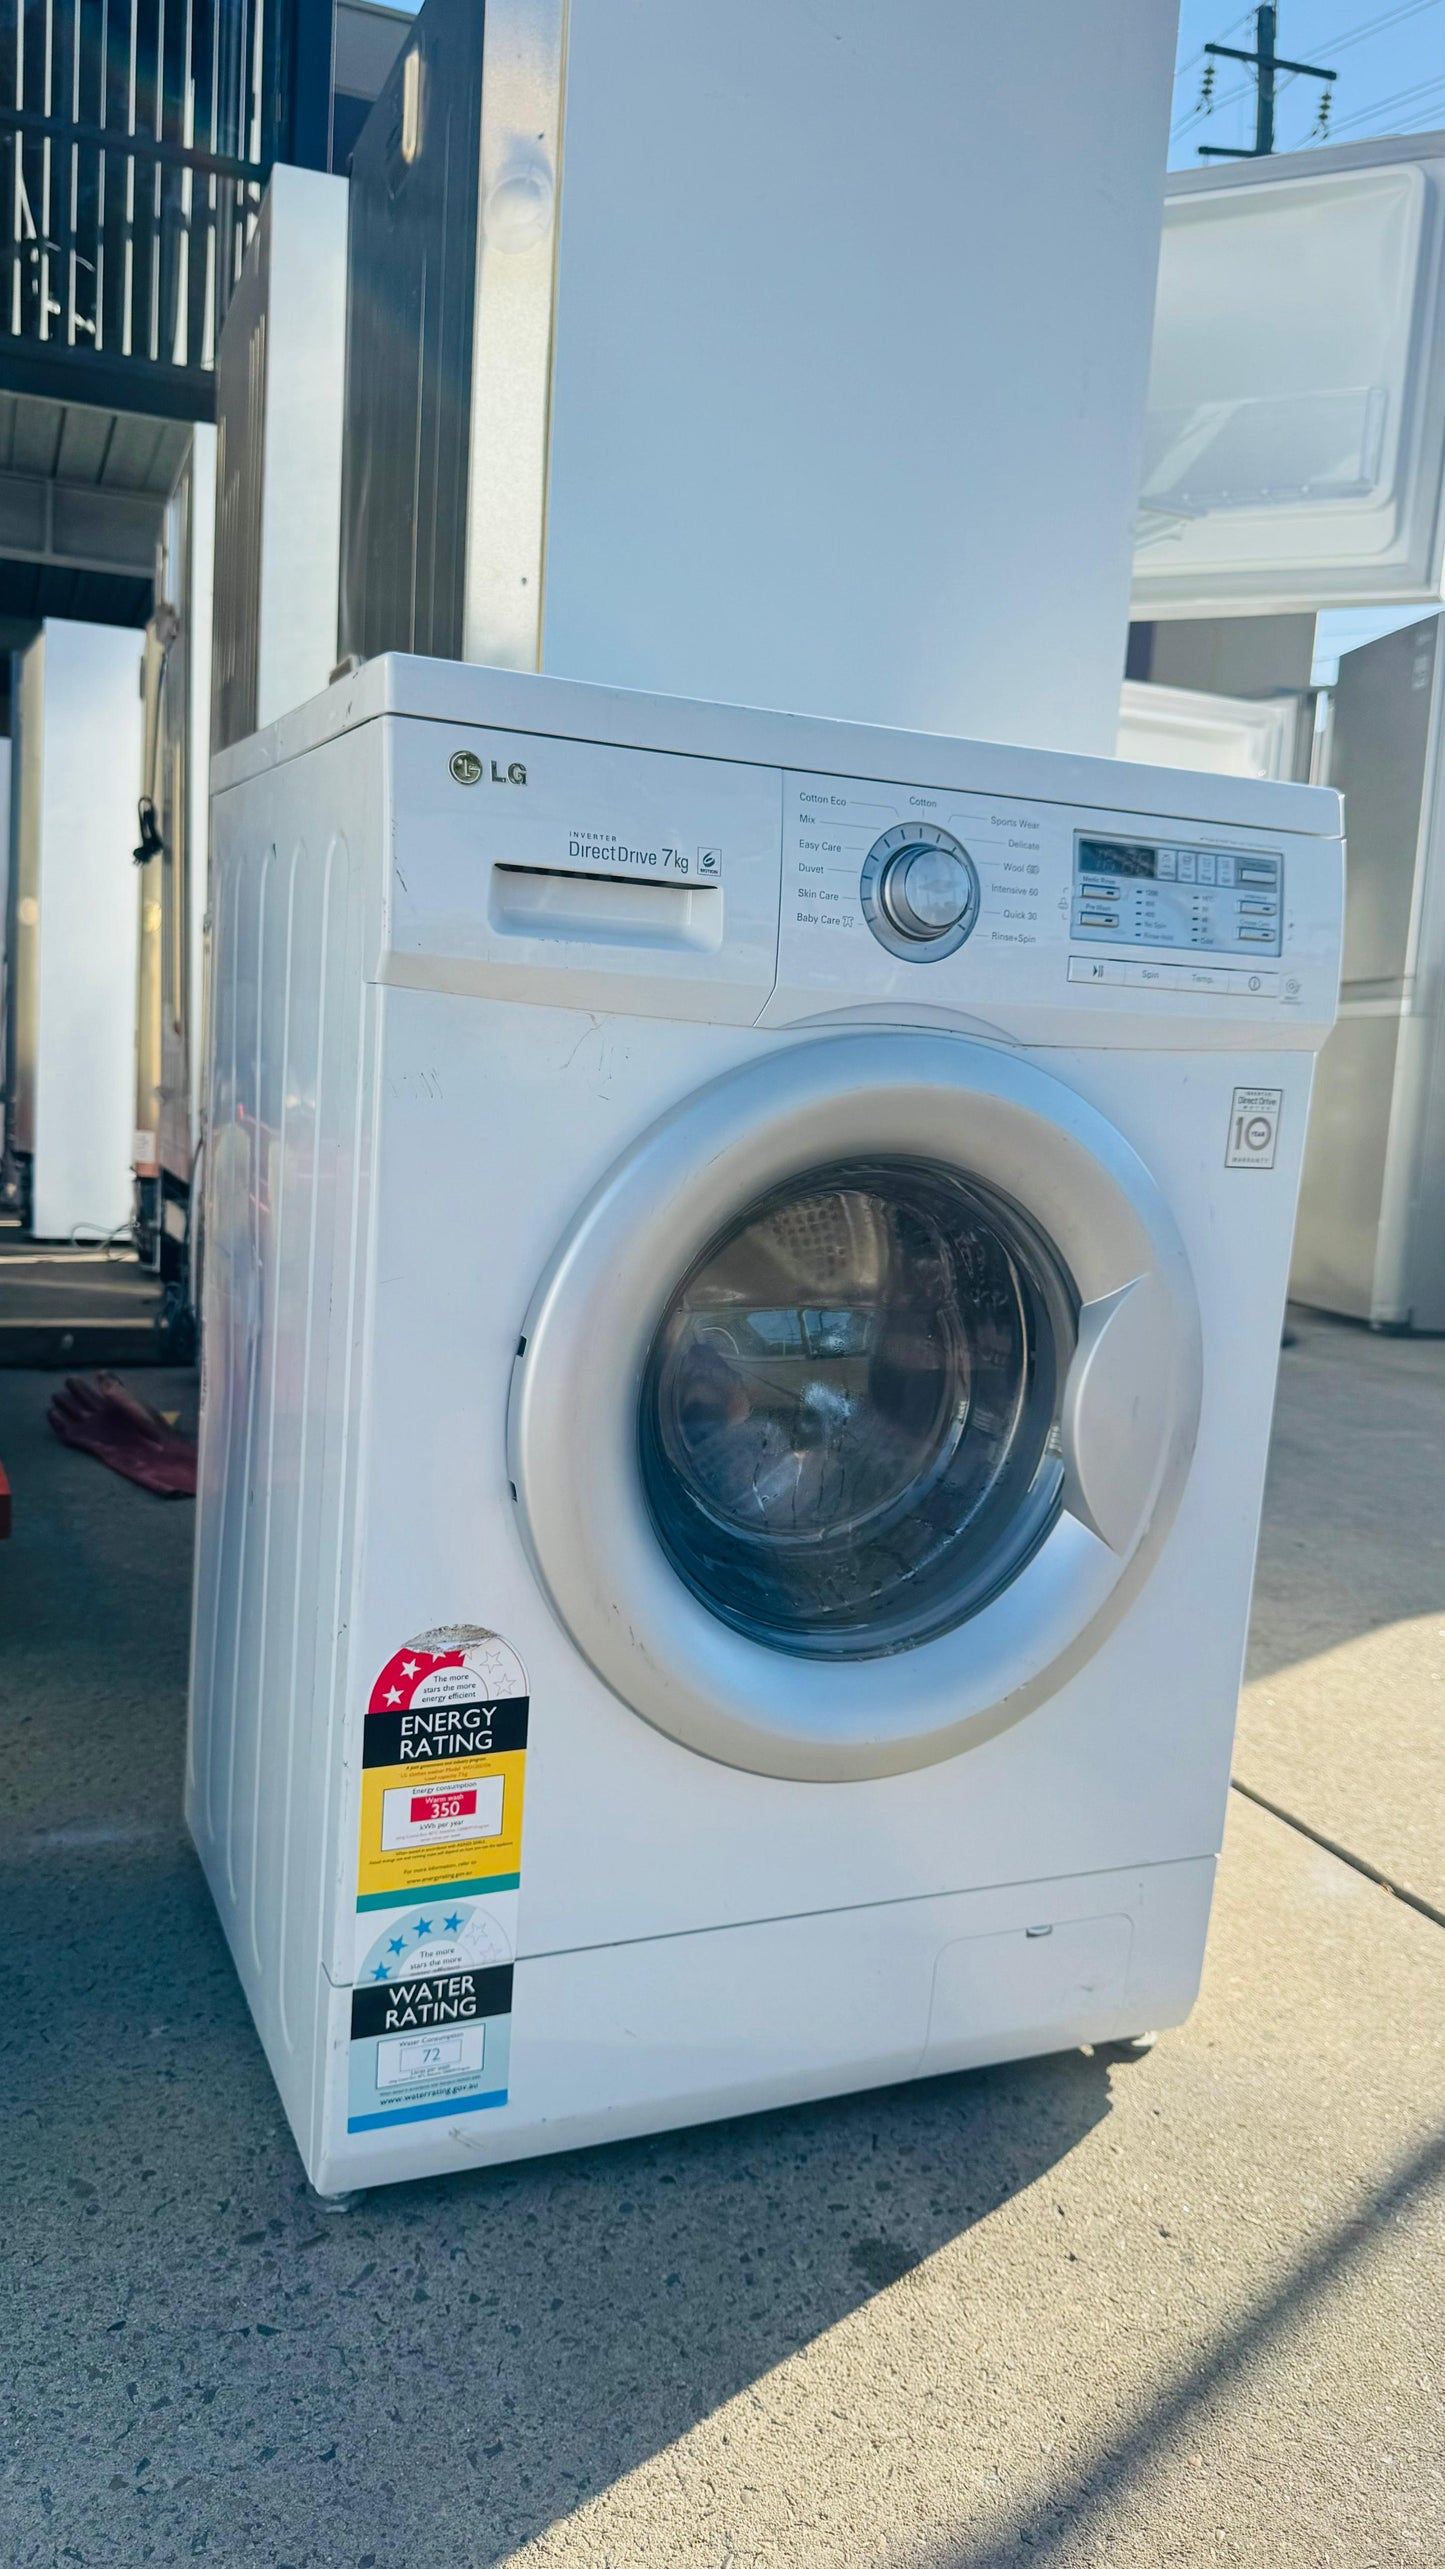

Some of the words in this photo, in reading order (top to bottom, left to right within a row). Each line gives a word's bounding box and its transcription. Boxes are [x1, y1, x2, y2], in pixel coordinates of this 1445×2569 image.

[491, 759, 528, 785] LG
[799, 792, 829, 805] Cotton
[830, 796, 847, 807] Eco
[909, 796, 937, 808] Cotton
[799, 814, 816, 825] Mix
[990, 816, 1017, 829] Sports
[1018, 819, 1040, 830] Wear
[569, 830, 617, 842] INVERTER
[799, 839, 820, 852] Easy
[821, 842, 842, 853] Care
[1008, 839, 1040, 851] Delicate
[798, 863, 824, 874] Duvet
[1003, 863, 1025, 873] Wool
[797, 888, 817, 899] Skin
[818, 891, 839, 901] Care
[991, 884, 1028, 895] Intensive
[1028, 887, 1039, 897] 60
[797, 913, 820, 926] Baby
[821, 915, 841, 925] Care
[1003, 909, 1026, 920] Quick
[1027, 911, 1038, 921] 30
[991, 931, 1037, 943] Rinse+Spin
[1141, 969, 1160, 980] Spin
[1235, 1116, 1272, 1151] 10
[433, 1674, 447, 1683] The
[449, 1673, 469, 1682] more
[423, 1686, 441, 1694] stars
[443, 1684, 455, 1692] the
[456, 1682, 476, 1690] more
[421, 1695, 446, 1703] energy
[448, 1691, 476, 1700] efficient
[401, 1706, 498, 1737] ENERGY
[400, 1730, 493, 1760] RATING
[412, 1786, 435, 1795] Energy
[435, 1781, 477, 1791] consumption
[425, 1796, 447, 1804] Warm
[431, 1801, 461, 1819] 350
[419, 1822, 437, 1830] kWh
[437, 1821, 448, 1829] per
[435, 1948, 455, 1956] more
[410, 1962, 427, 1970] stars
[442, 1957, 462, 1965] more
[389, 1975, 475, 2006] WATER
[385, 1996, 477, 2029] RATING
[422, 2047, 441, 2063] 72
[379, 2082, 479, 2105] www.waterrating.gov.au
